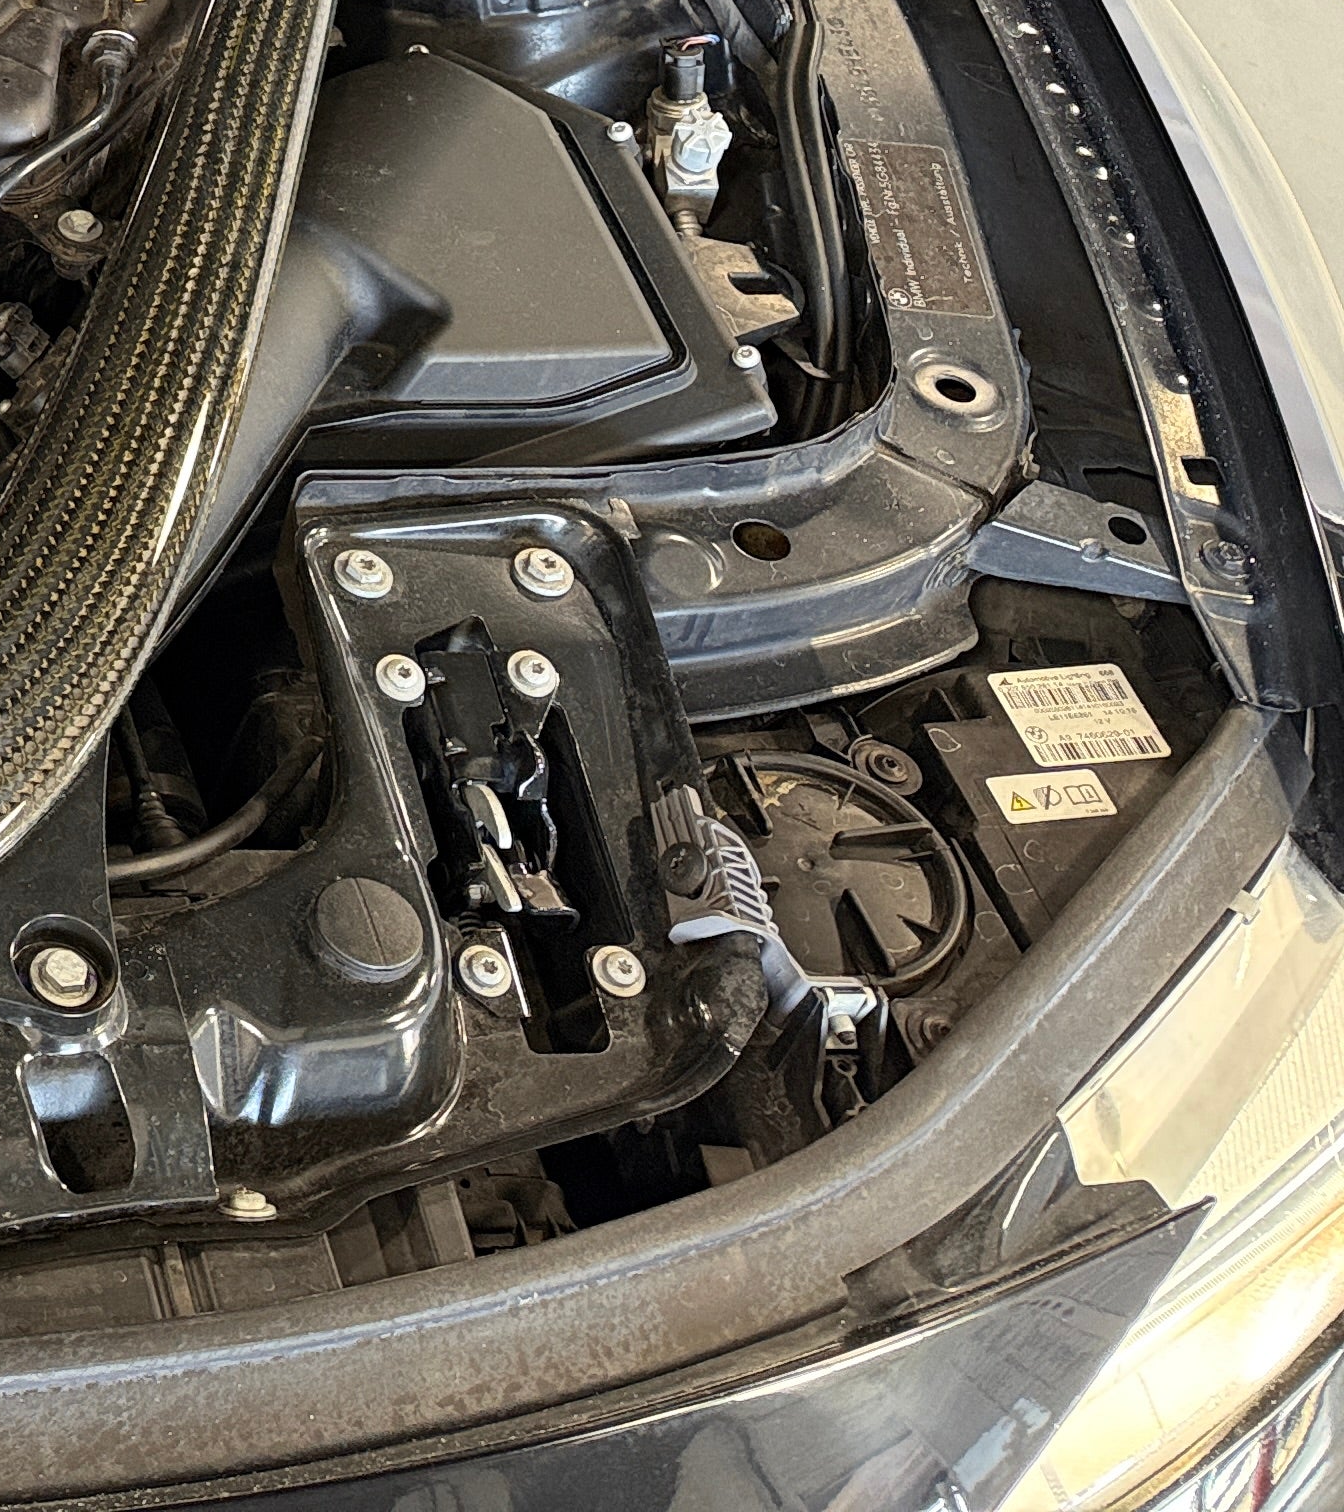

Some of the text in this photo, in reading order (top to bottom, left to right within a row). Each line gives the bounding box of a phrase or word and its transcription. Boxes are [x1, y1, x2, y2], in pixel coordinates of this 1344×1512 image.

[896, 227, 917, 276] Individual
[954, 241, 974, 284] Technik
[908, 278, 927, 307] BMW
[1015, 674, 1058, 684] Automotive
[1060, 671, 1092, 681] Lighting
